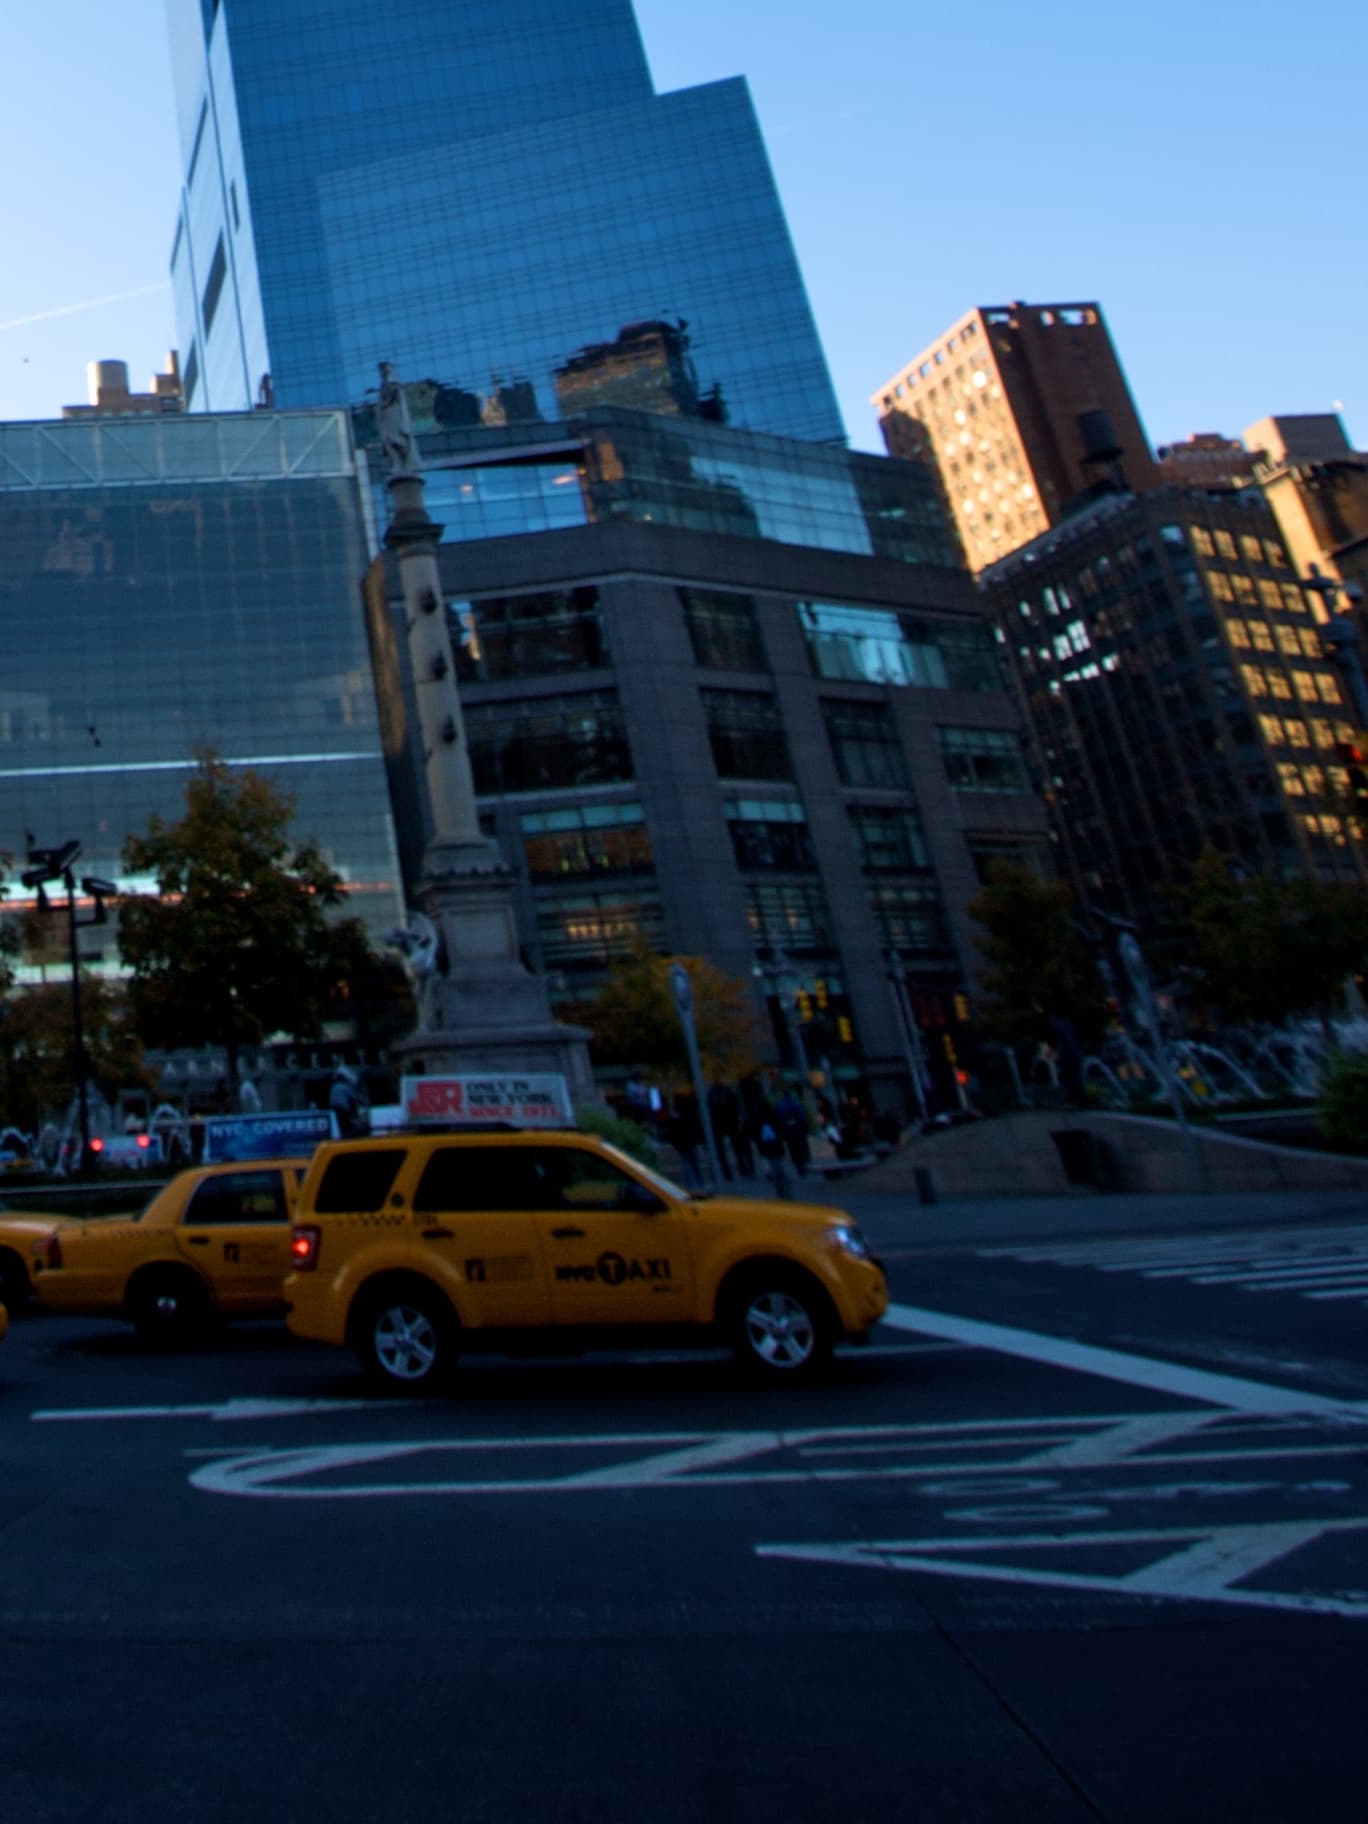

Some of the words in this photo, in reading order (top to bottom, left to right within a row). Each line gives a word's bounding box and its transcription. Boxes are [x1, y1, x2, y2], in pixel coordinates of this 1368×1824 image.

[468, 1093, 501, 1105] NEW
[507, 1092, 552, 1105] YORK
[211, 1122, 244, 1137] NYC
[252, 1116, 329, 1135] COVERED
[597, 1250, 672, 1286] TAXI
